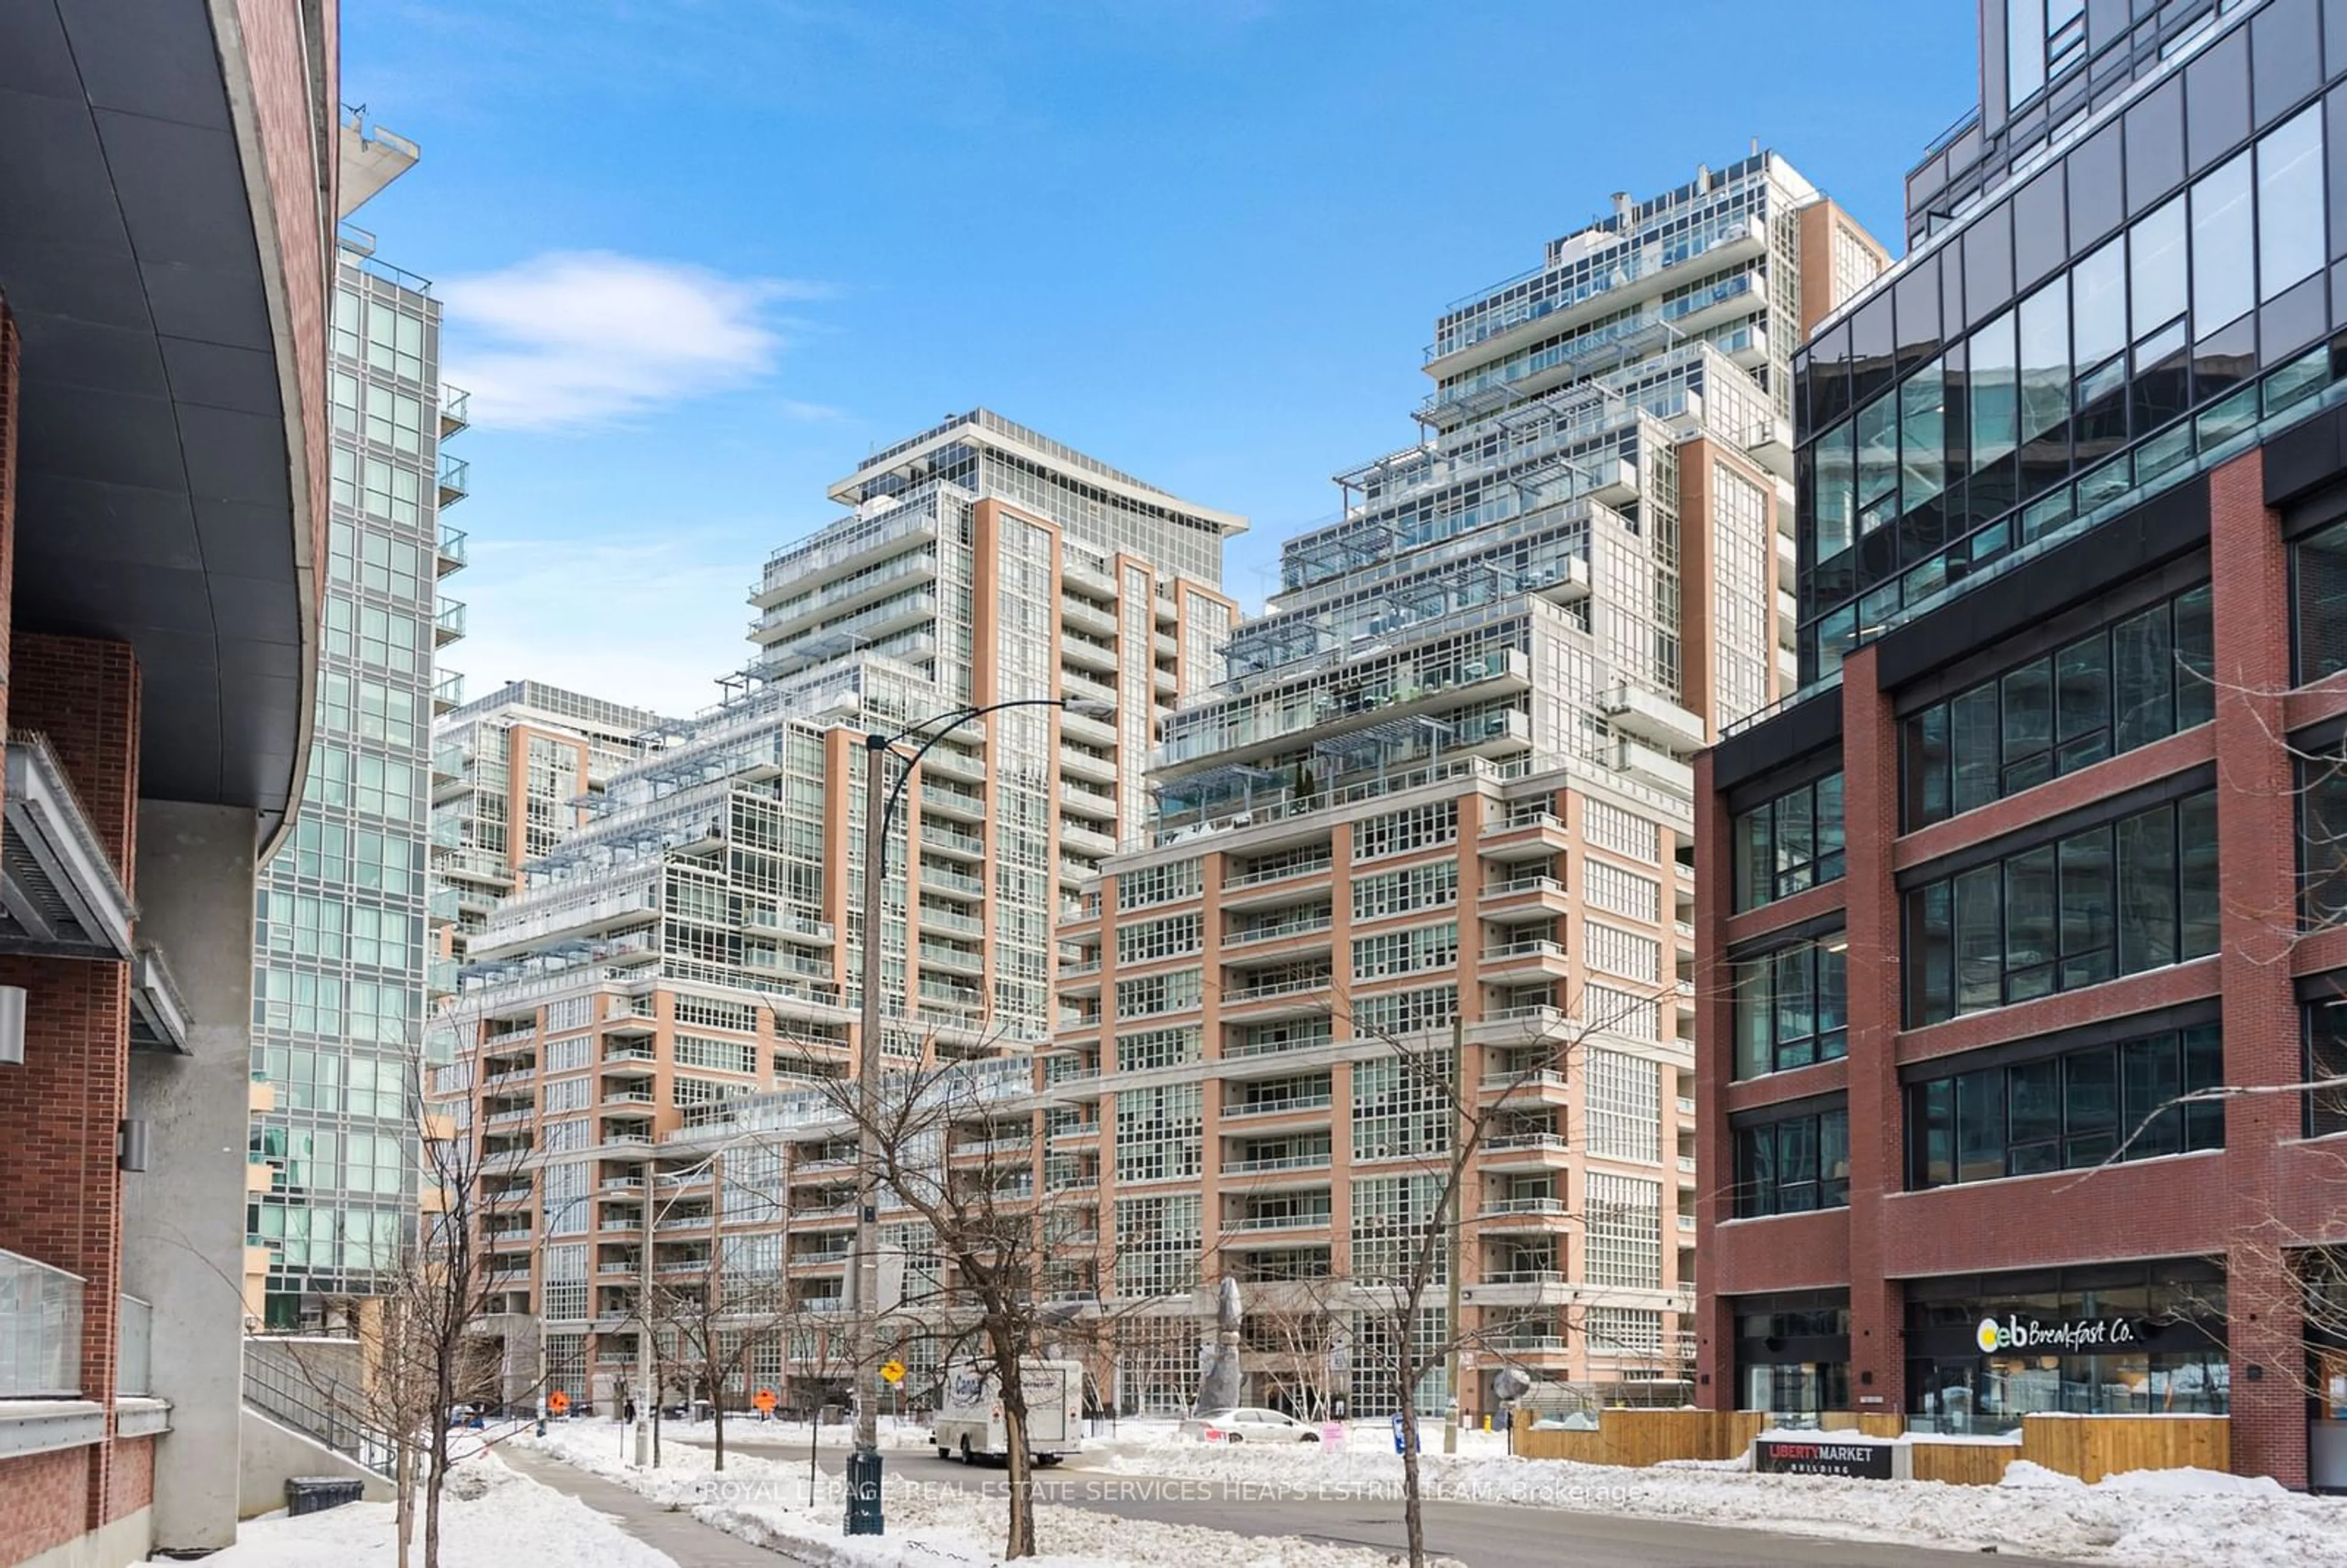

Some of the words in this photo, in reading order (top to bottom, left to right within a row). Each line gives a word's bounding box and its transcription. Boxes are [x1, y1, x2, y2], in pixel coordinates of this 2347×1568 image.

[2029, 1320, 2106, 1353] Breakfast
[2110, 1317, 2134, 1344] Co.
[1790, 1463, 1849, 1474] BUILDING
